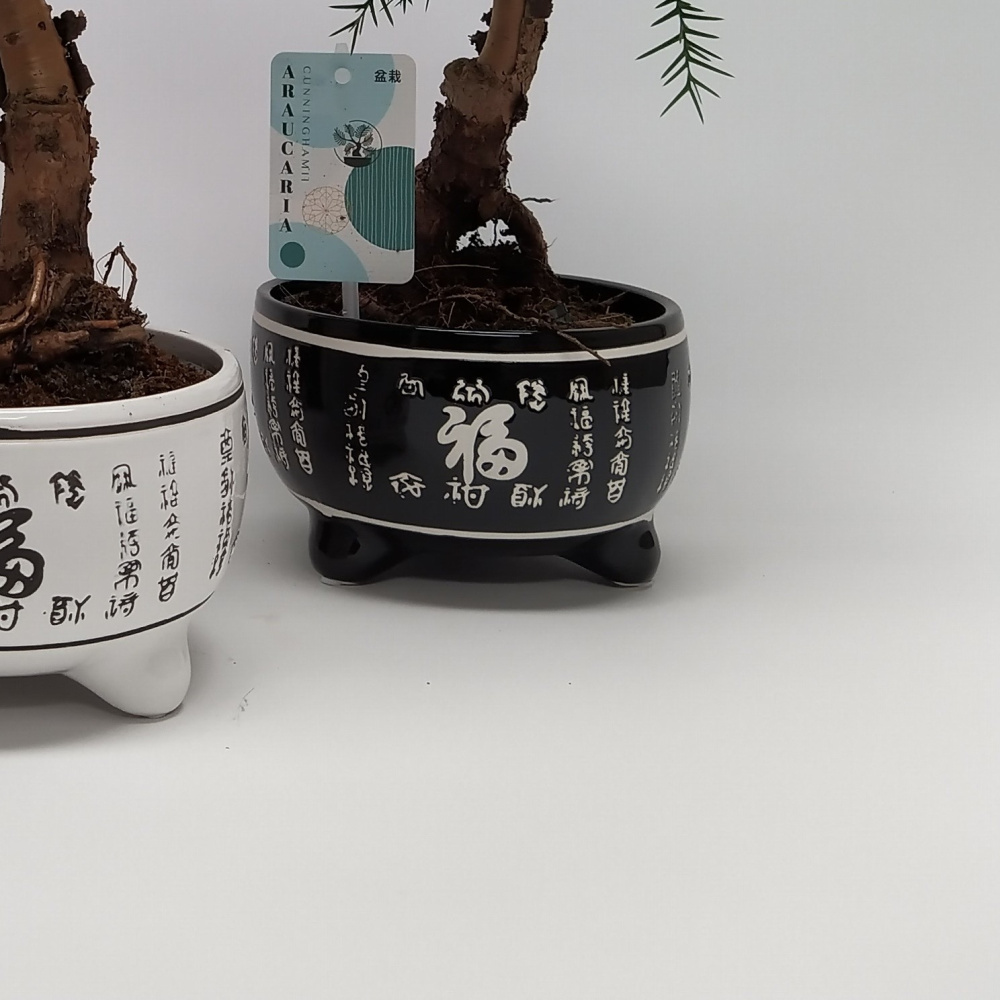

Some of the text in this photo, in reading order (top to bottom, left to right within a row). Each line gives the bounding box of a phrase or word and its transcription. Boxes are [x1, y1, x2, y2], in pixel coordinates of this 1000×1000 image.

[374, 69, 402, 83] 盆栽
[279, 64, 295, 233] ARAUCARIA
[437, 403, 529, 485] 福
